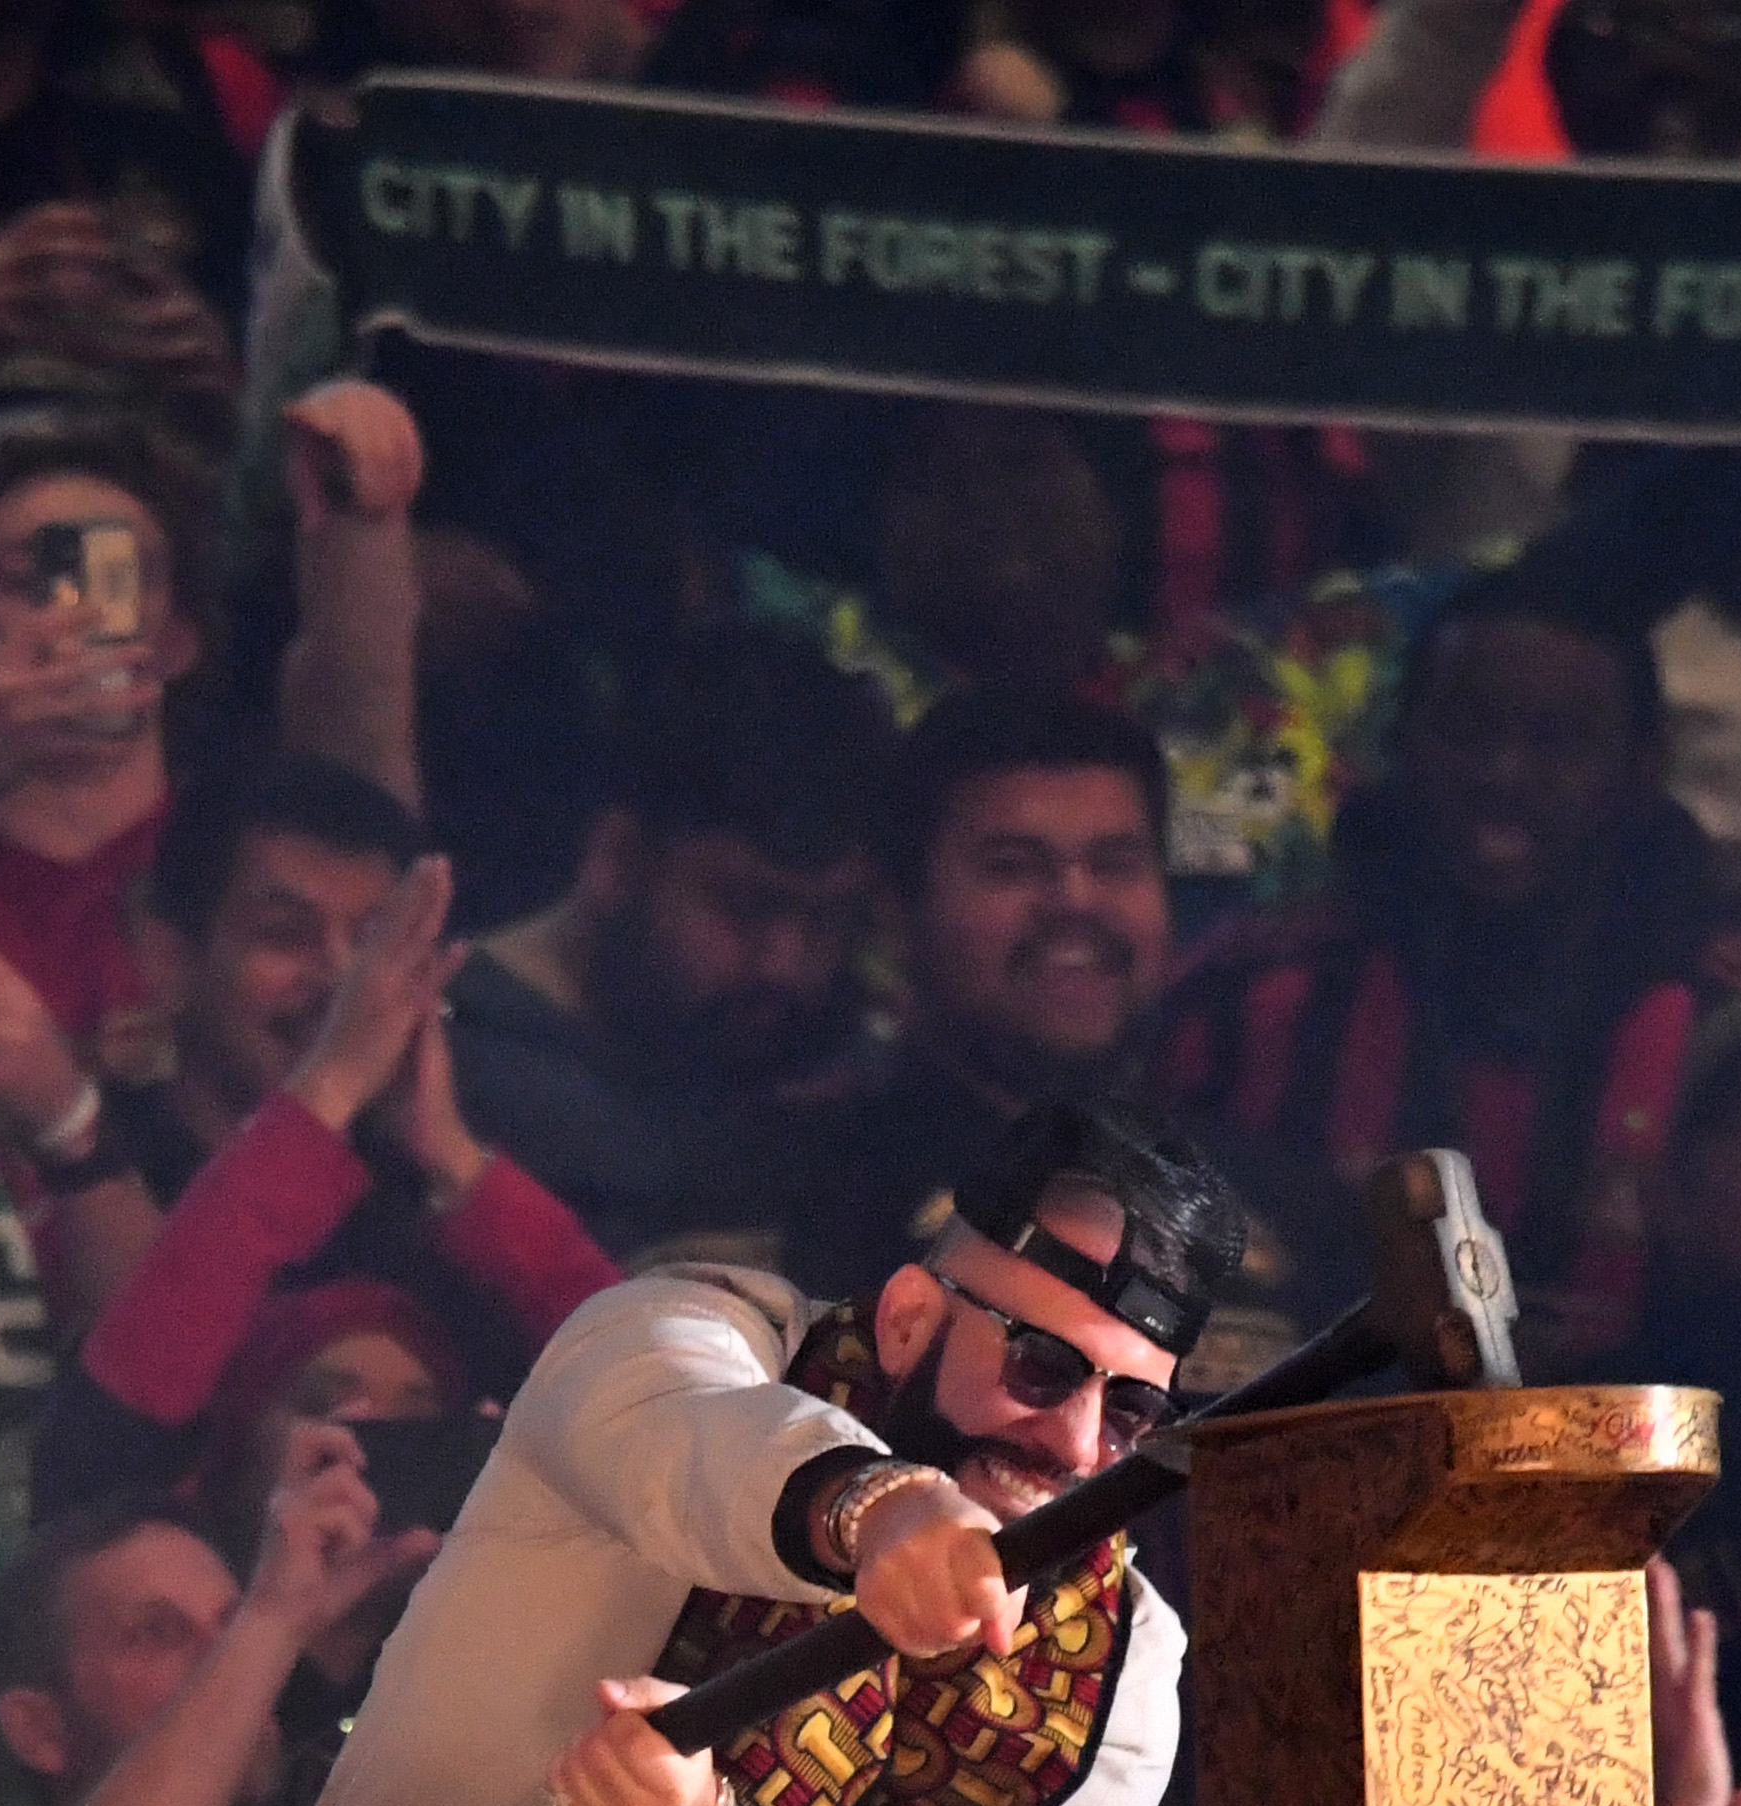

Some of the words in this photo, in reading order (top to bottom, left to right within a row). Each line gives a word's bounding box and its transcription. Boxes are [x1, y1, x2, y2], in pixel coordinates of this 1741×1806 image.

[361, 159, 540, 250] CITY
[558, 183, 636, 265] IN
[655, 187, 801, 284] THE
[818, 208, 1116, 305] FOREST
[1196, 240, 1377, 327] CITY
[1391, 255, 1471, 330] IN
[1488, 253, 1640, 340] THE
